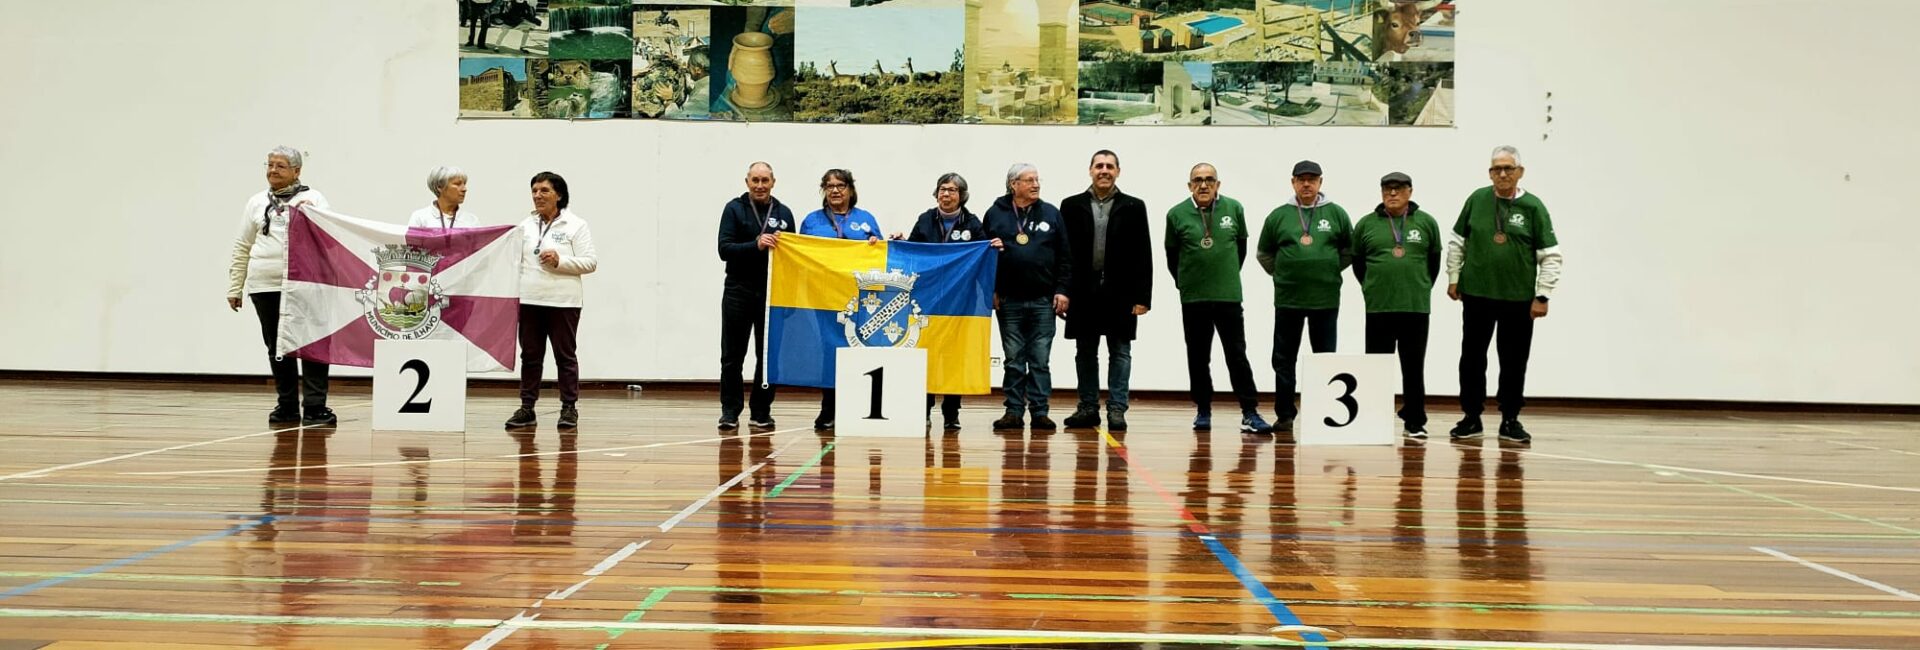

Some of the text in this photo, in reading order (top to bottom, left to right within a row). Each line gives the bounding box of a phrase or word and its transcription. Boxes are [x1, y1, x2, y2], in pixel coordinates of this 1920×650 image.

[398, 359, 433, 413] 2
[862, 366, 890, 420] 1
[1323, 372, 1359, 428] 3
